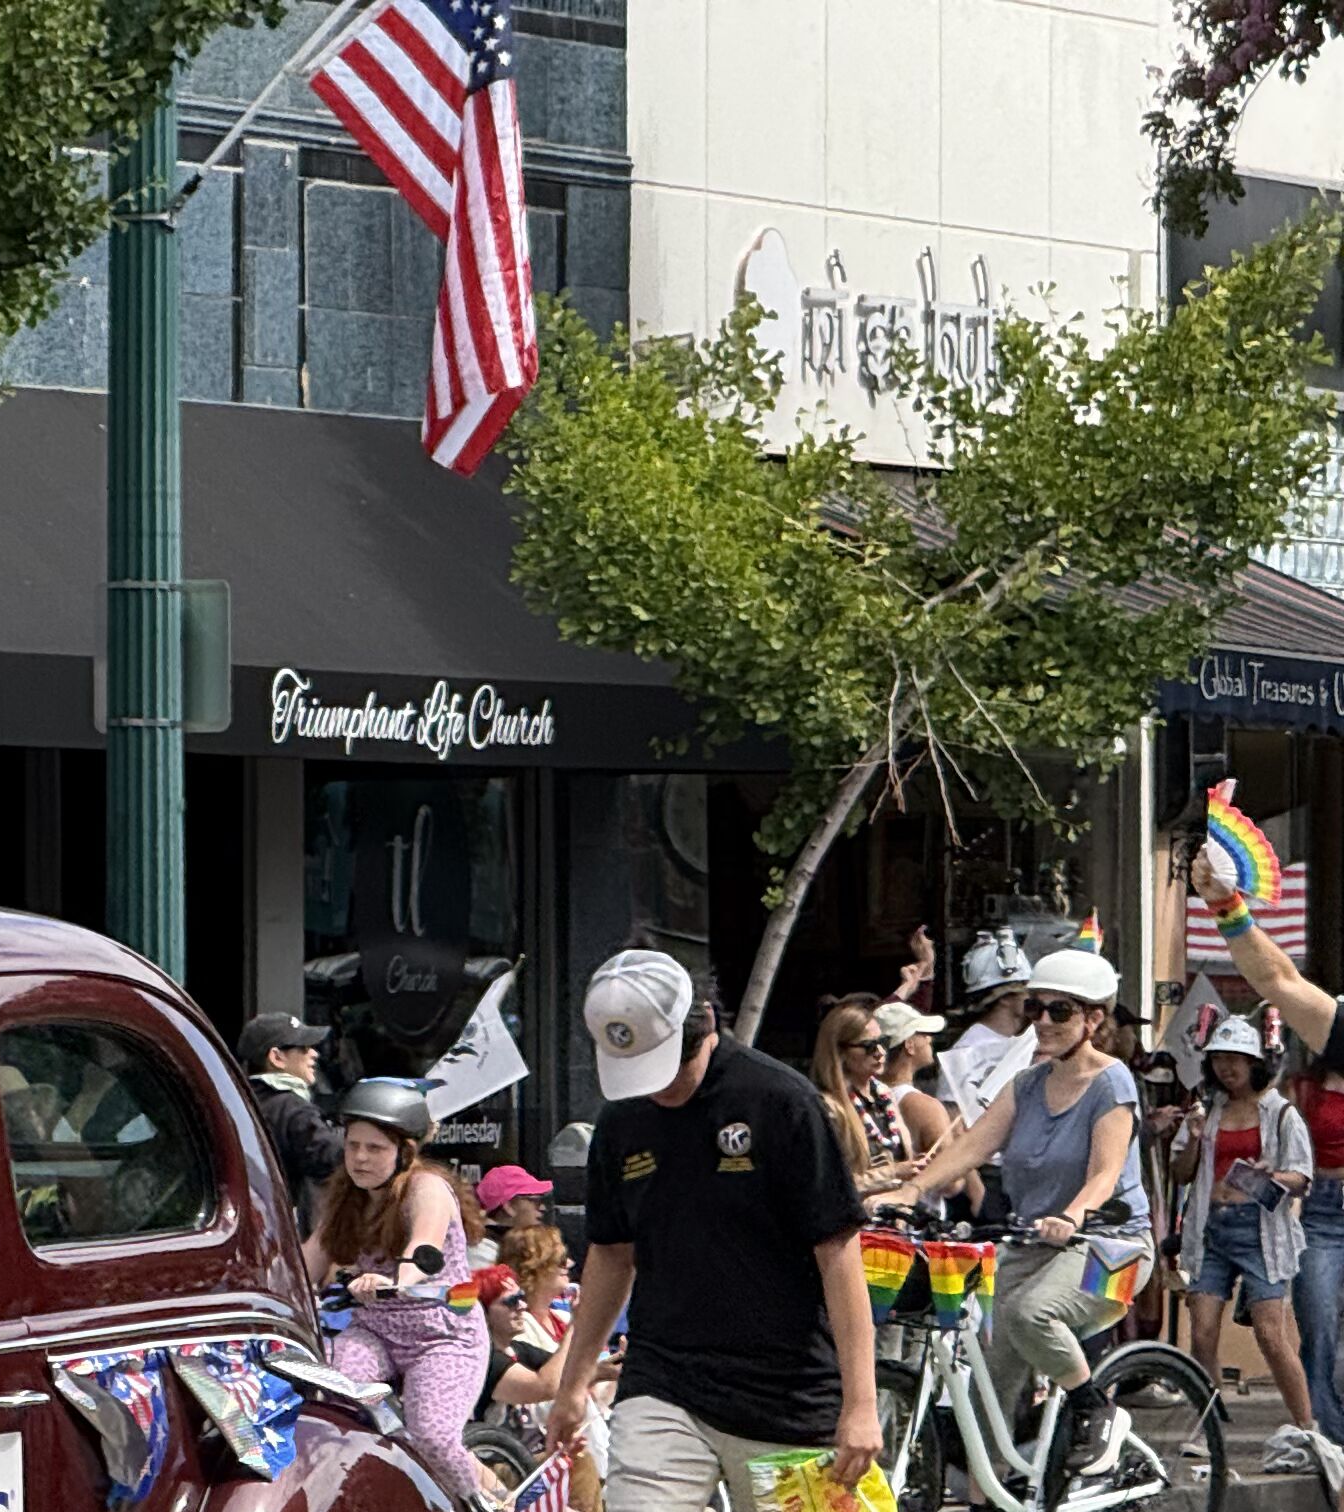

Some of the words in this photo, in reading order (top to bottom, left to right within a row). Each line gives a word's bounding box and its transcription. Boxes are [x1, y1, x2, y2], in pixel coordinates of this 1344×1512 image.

[271, 667, 417, 755] Triumphant
[416, 680, 466, 761] Life
[467, 684, 555, 750] Church
[434, 1115, 502, 1149] ednesday
